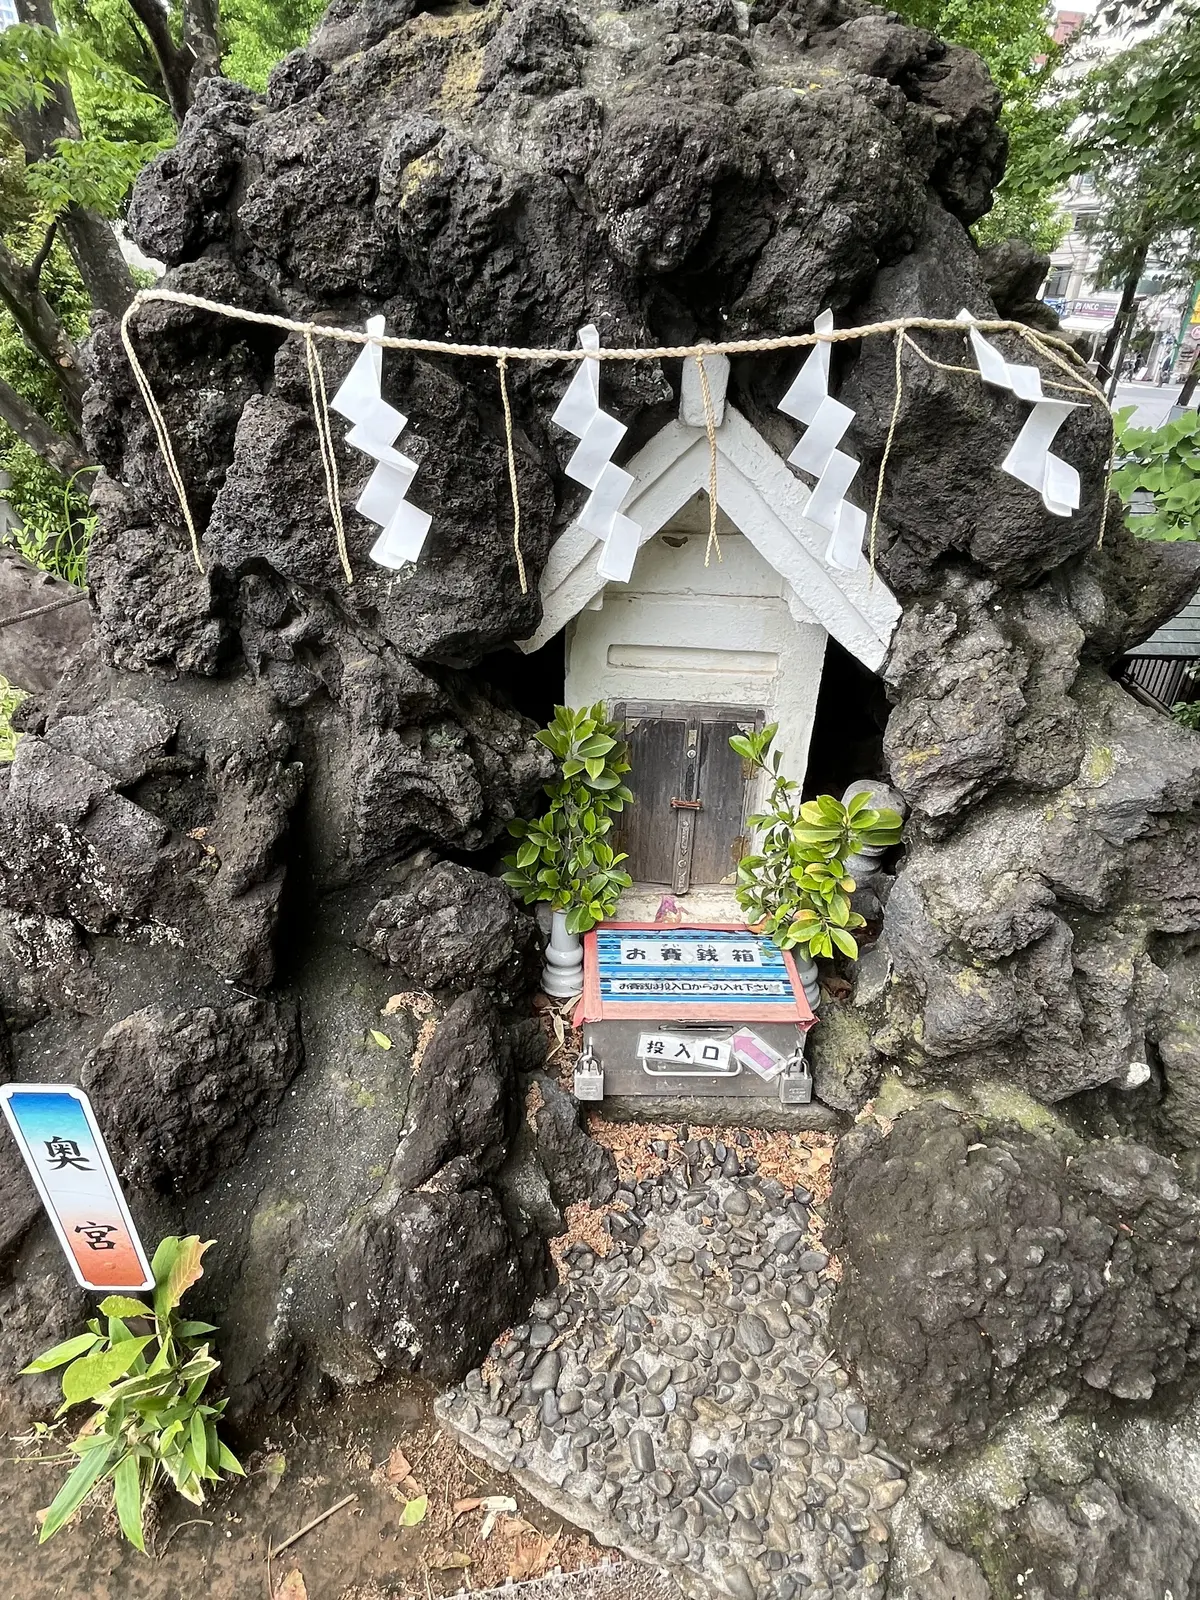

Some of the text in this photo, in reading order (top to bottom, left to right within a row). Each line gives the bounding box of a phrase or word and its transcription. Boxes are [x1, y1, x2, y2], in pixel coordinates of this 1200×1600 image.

[646, 1040, 720, 1061] 投入口
[43, 1135, 119, 1251] 奥宮
